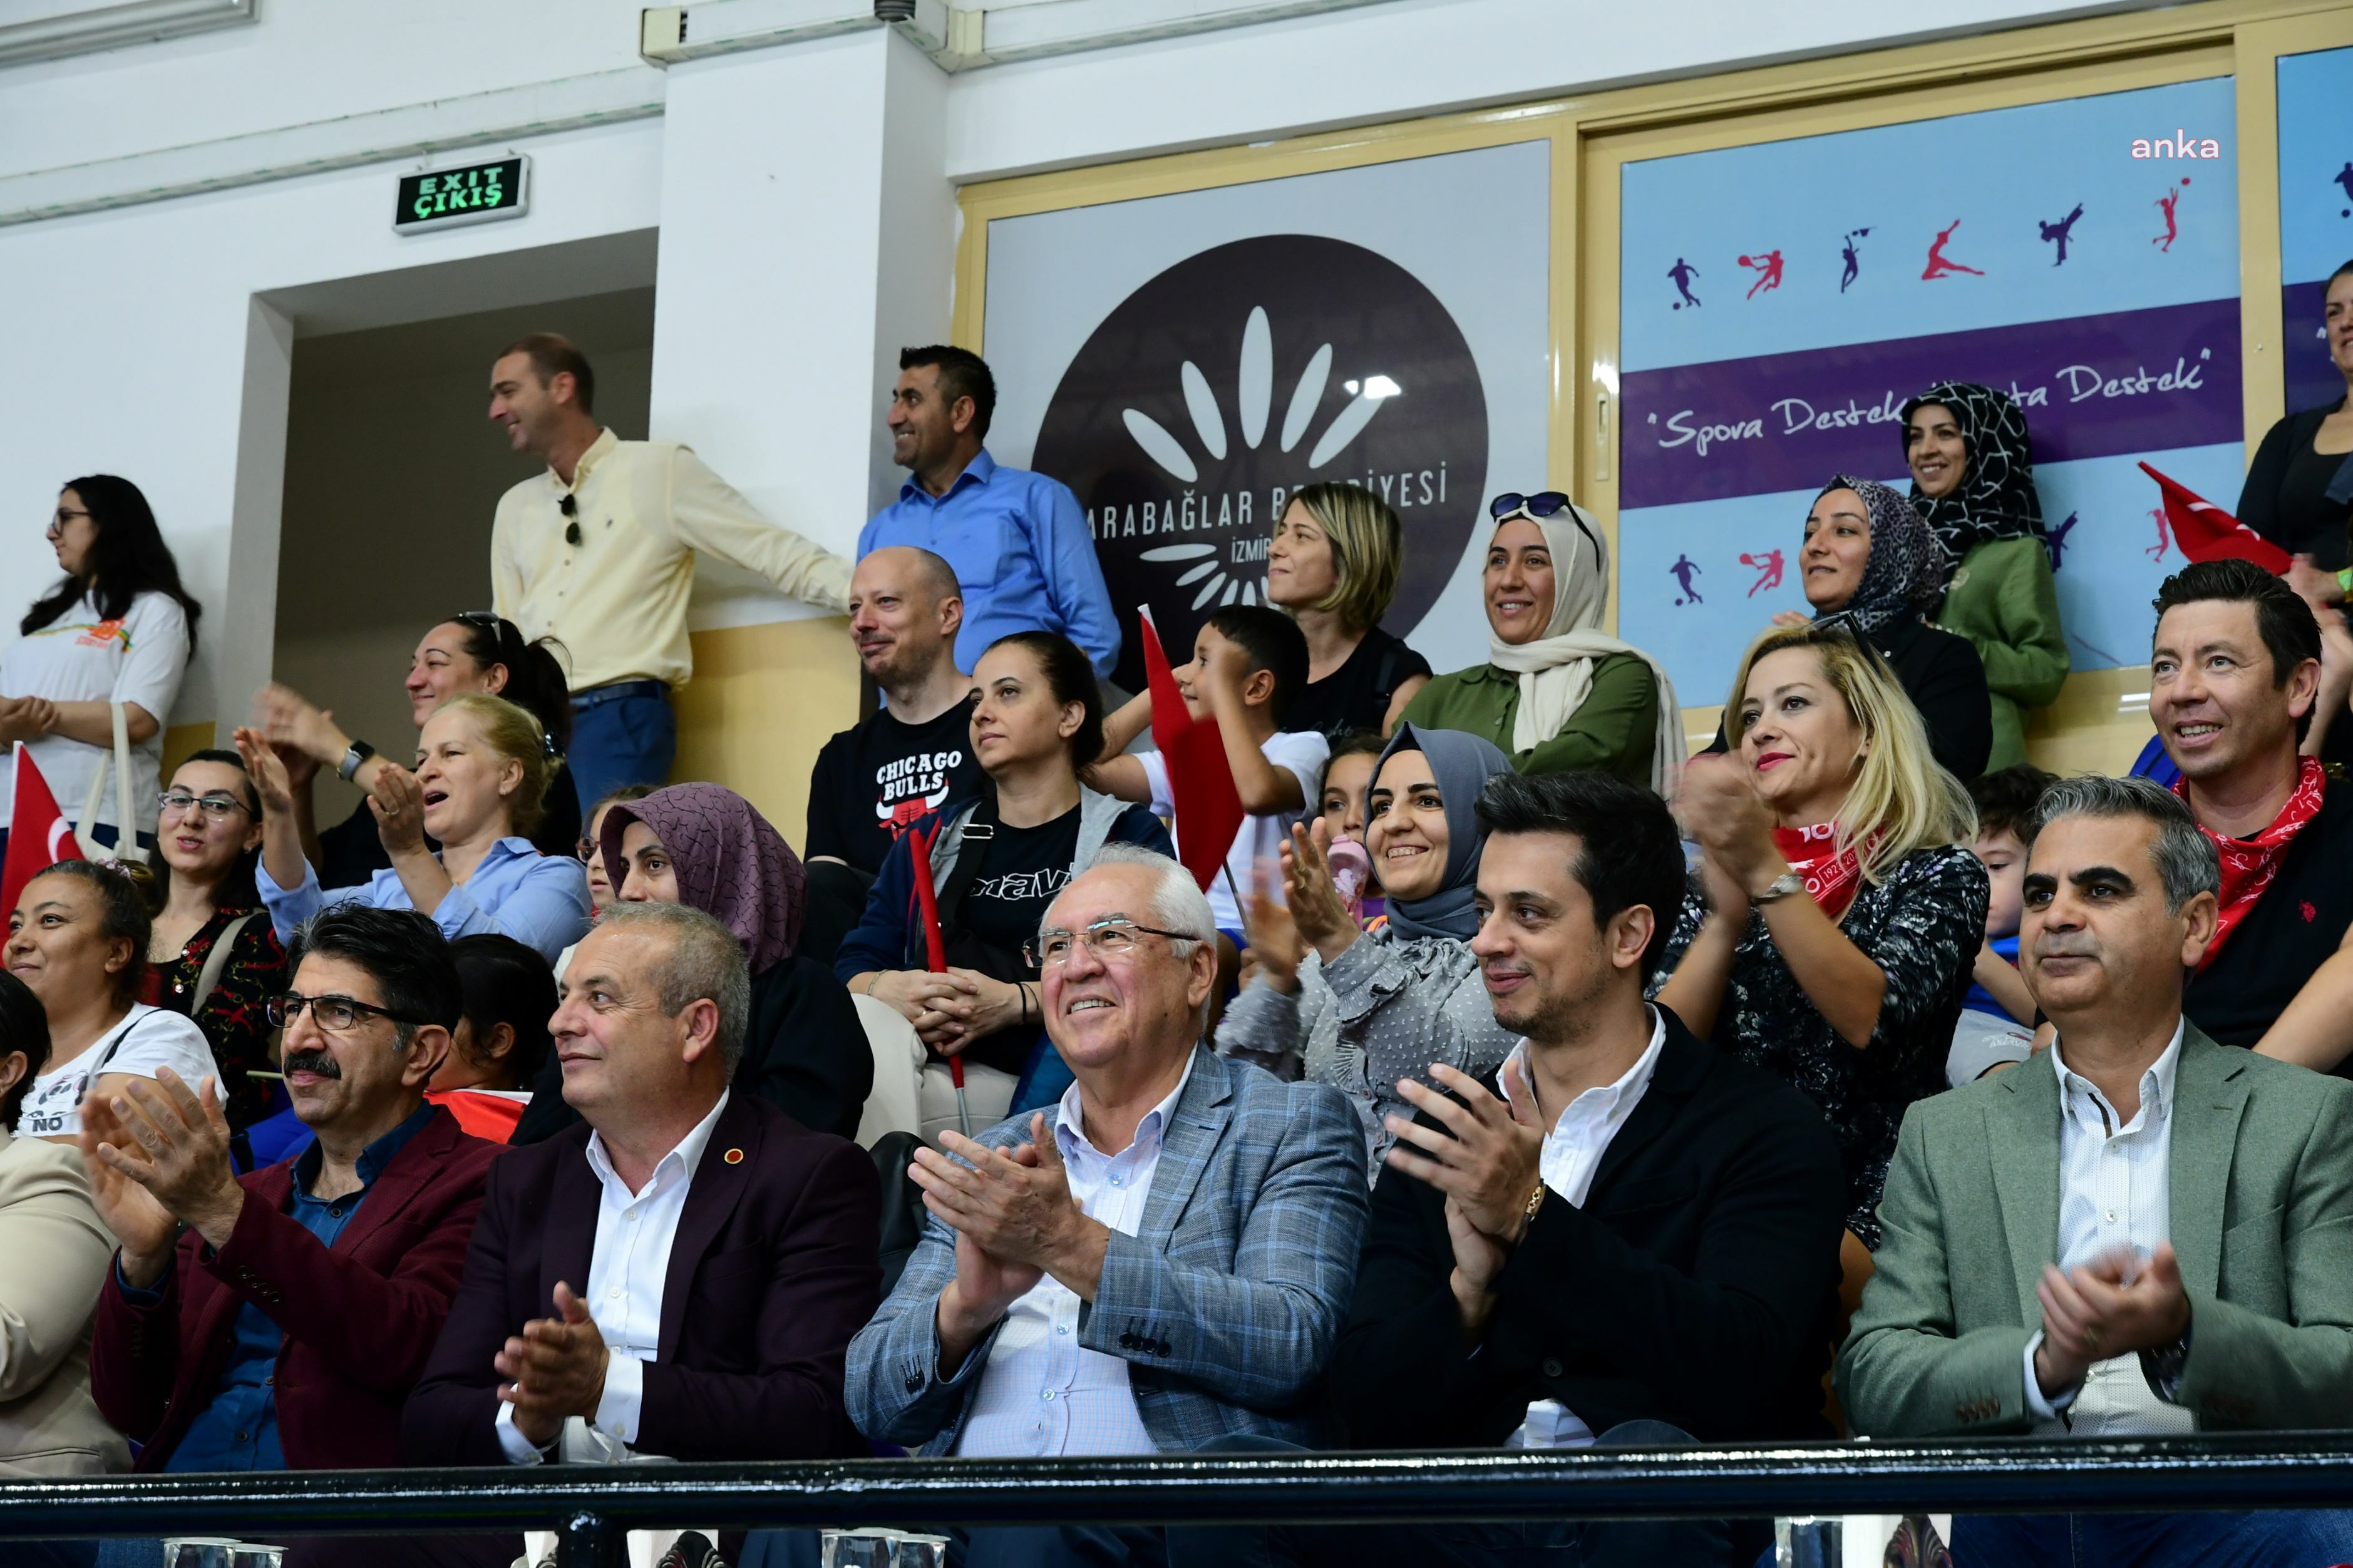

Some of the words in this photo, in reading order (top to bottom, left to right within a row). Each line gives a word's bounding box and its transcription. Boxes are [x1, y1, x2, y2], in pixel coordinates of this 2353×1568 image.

[419, 167, 503, 195] EXIT
[414, 183, 502, 218] ÇIKIŞ
[1771, 390, 1908, 434] Destek
[1087, 489, 1252, 540] ARABAĞLAR
[1272, 461, 1446, 521] BİYESİ
[877, 751, 962, 784] CHICAGO
[883, 772, 944, 801] BULLS
[969, 862, 1074, 901] mav
[33, 1117, 63, 1132] NO
